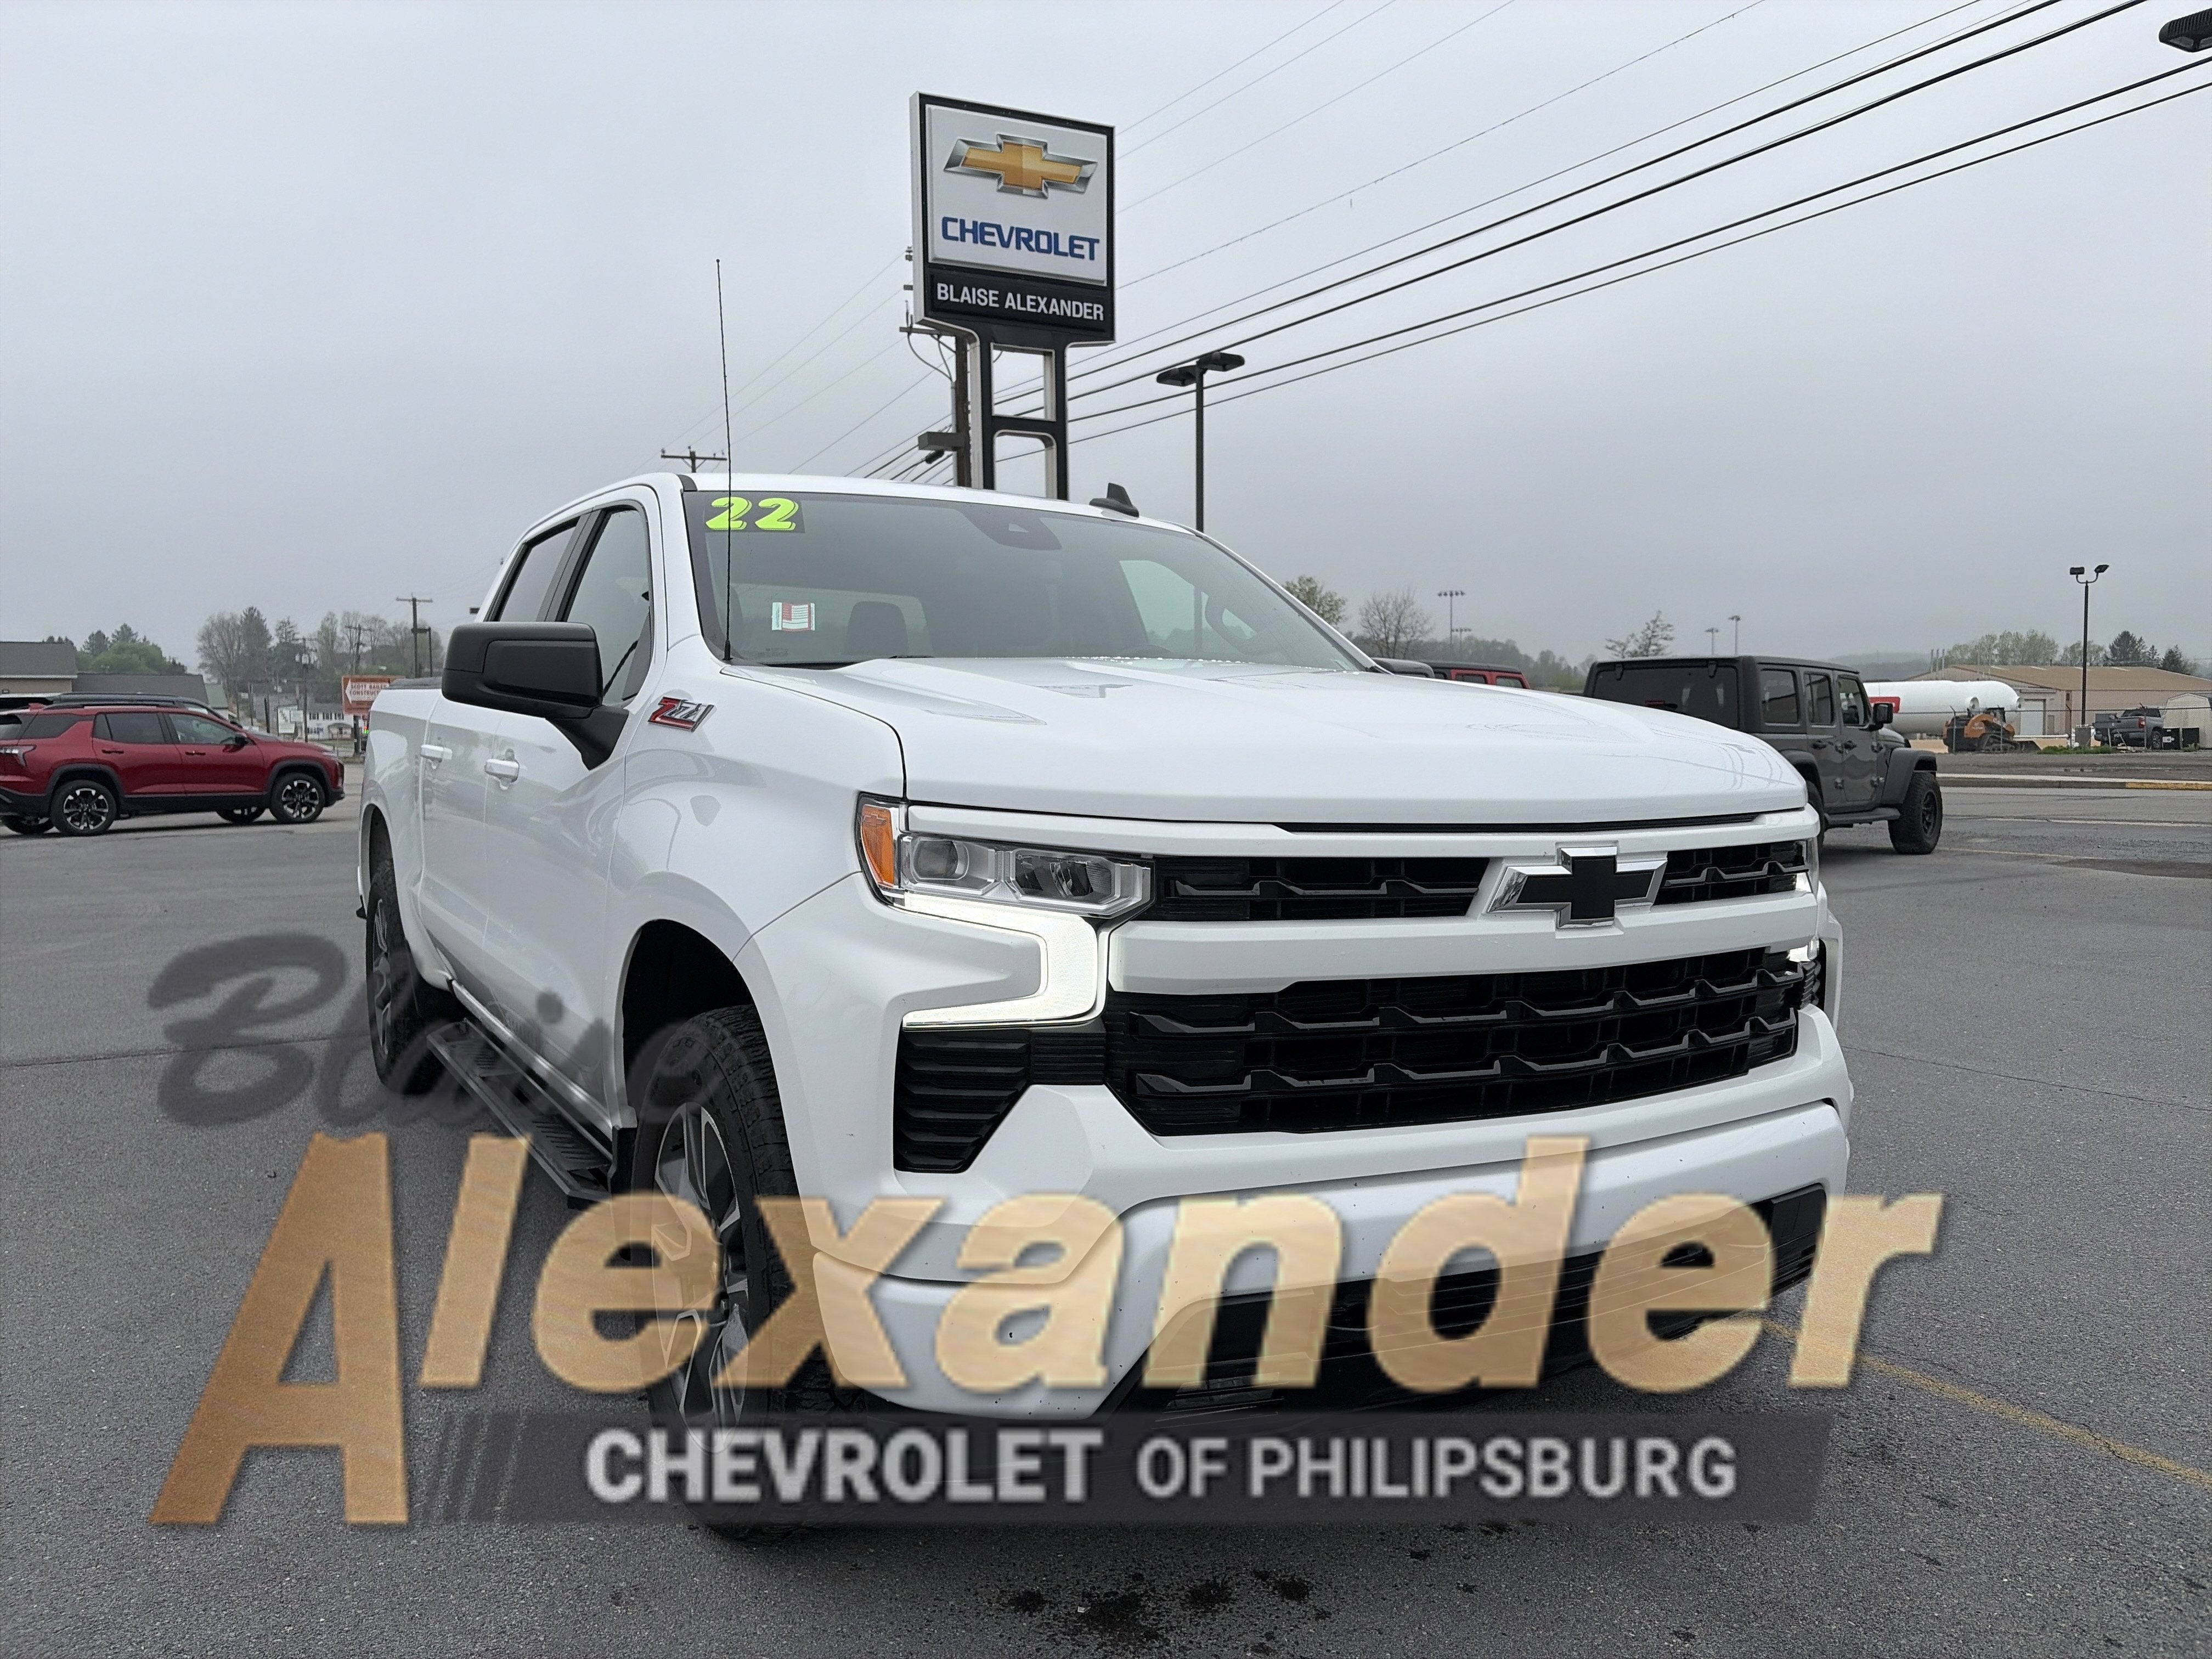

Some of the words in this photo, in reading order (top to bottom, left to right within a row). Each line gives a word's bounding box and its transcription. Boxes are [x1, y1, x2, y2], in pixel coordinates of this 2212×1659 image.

[941, 216, 1100, 261] CHEVROLET
[936, 282, 1000, 307] BLAISE
[1005, 292, 1104, 321] ALEXANDER
[706, 496, 799, 531] 22
[647, 696, 715, 732] Z71
